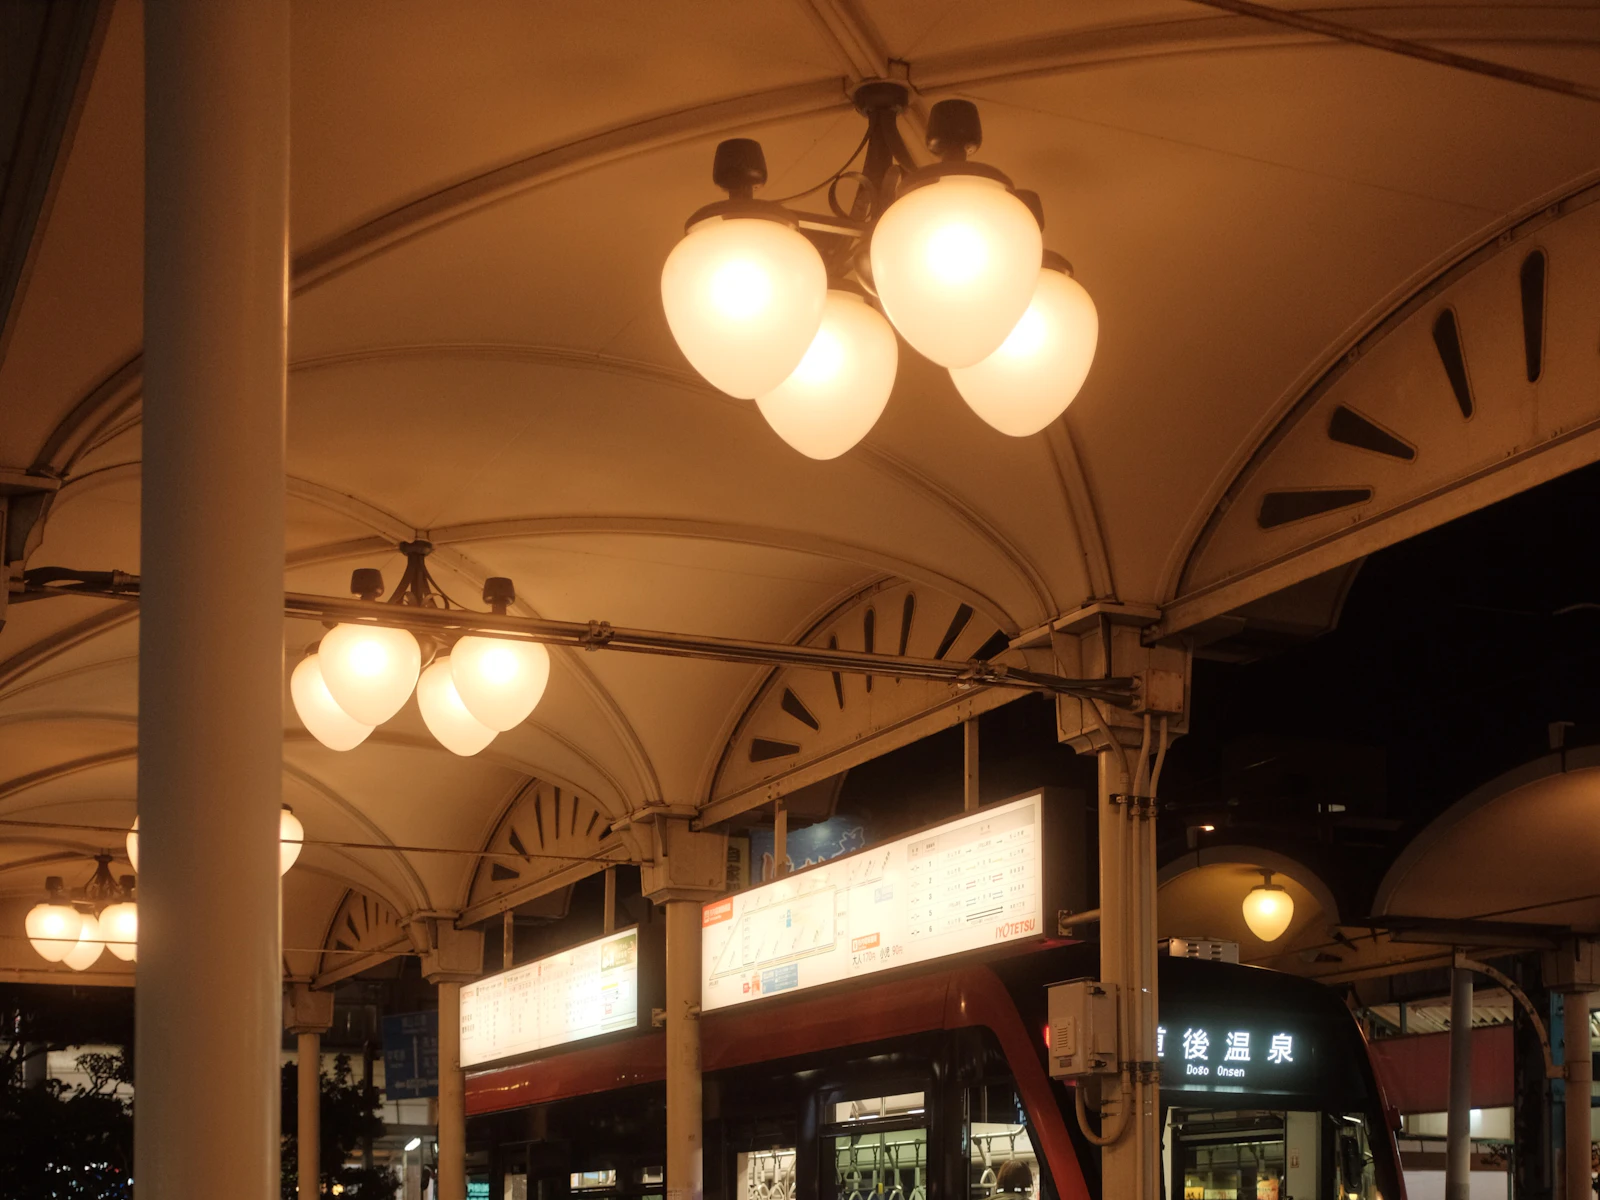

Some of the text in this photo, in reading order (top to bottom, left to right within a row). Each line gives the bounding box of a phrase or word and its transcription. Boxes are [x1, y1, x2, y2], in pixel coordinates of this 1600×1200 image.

[995, 917, 1036, 939] IYOTETSU
[1186, 1063, 1245, 1078] Dogo Onsen
